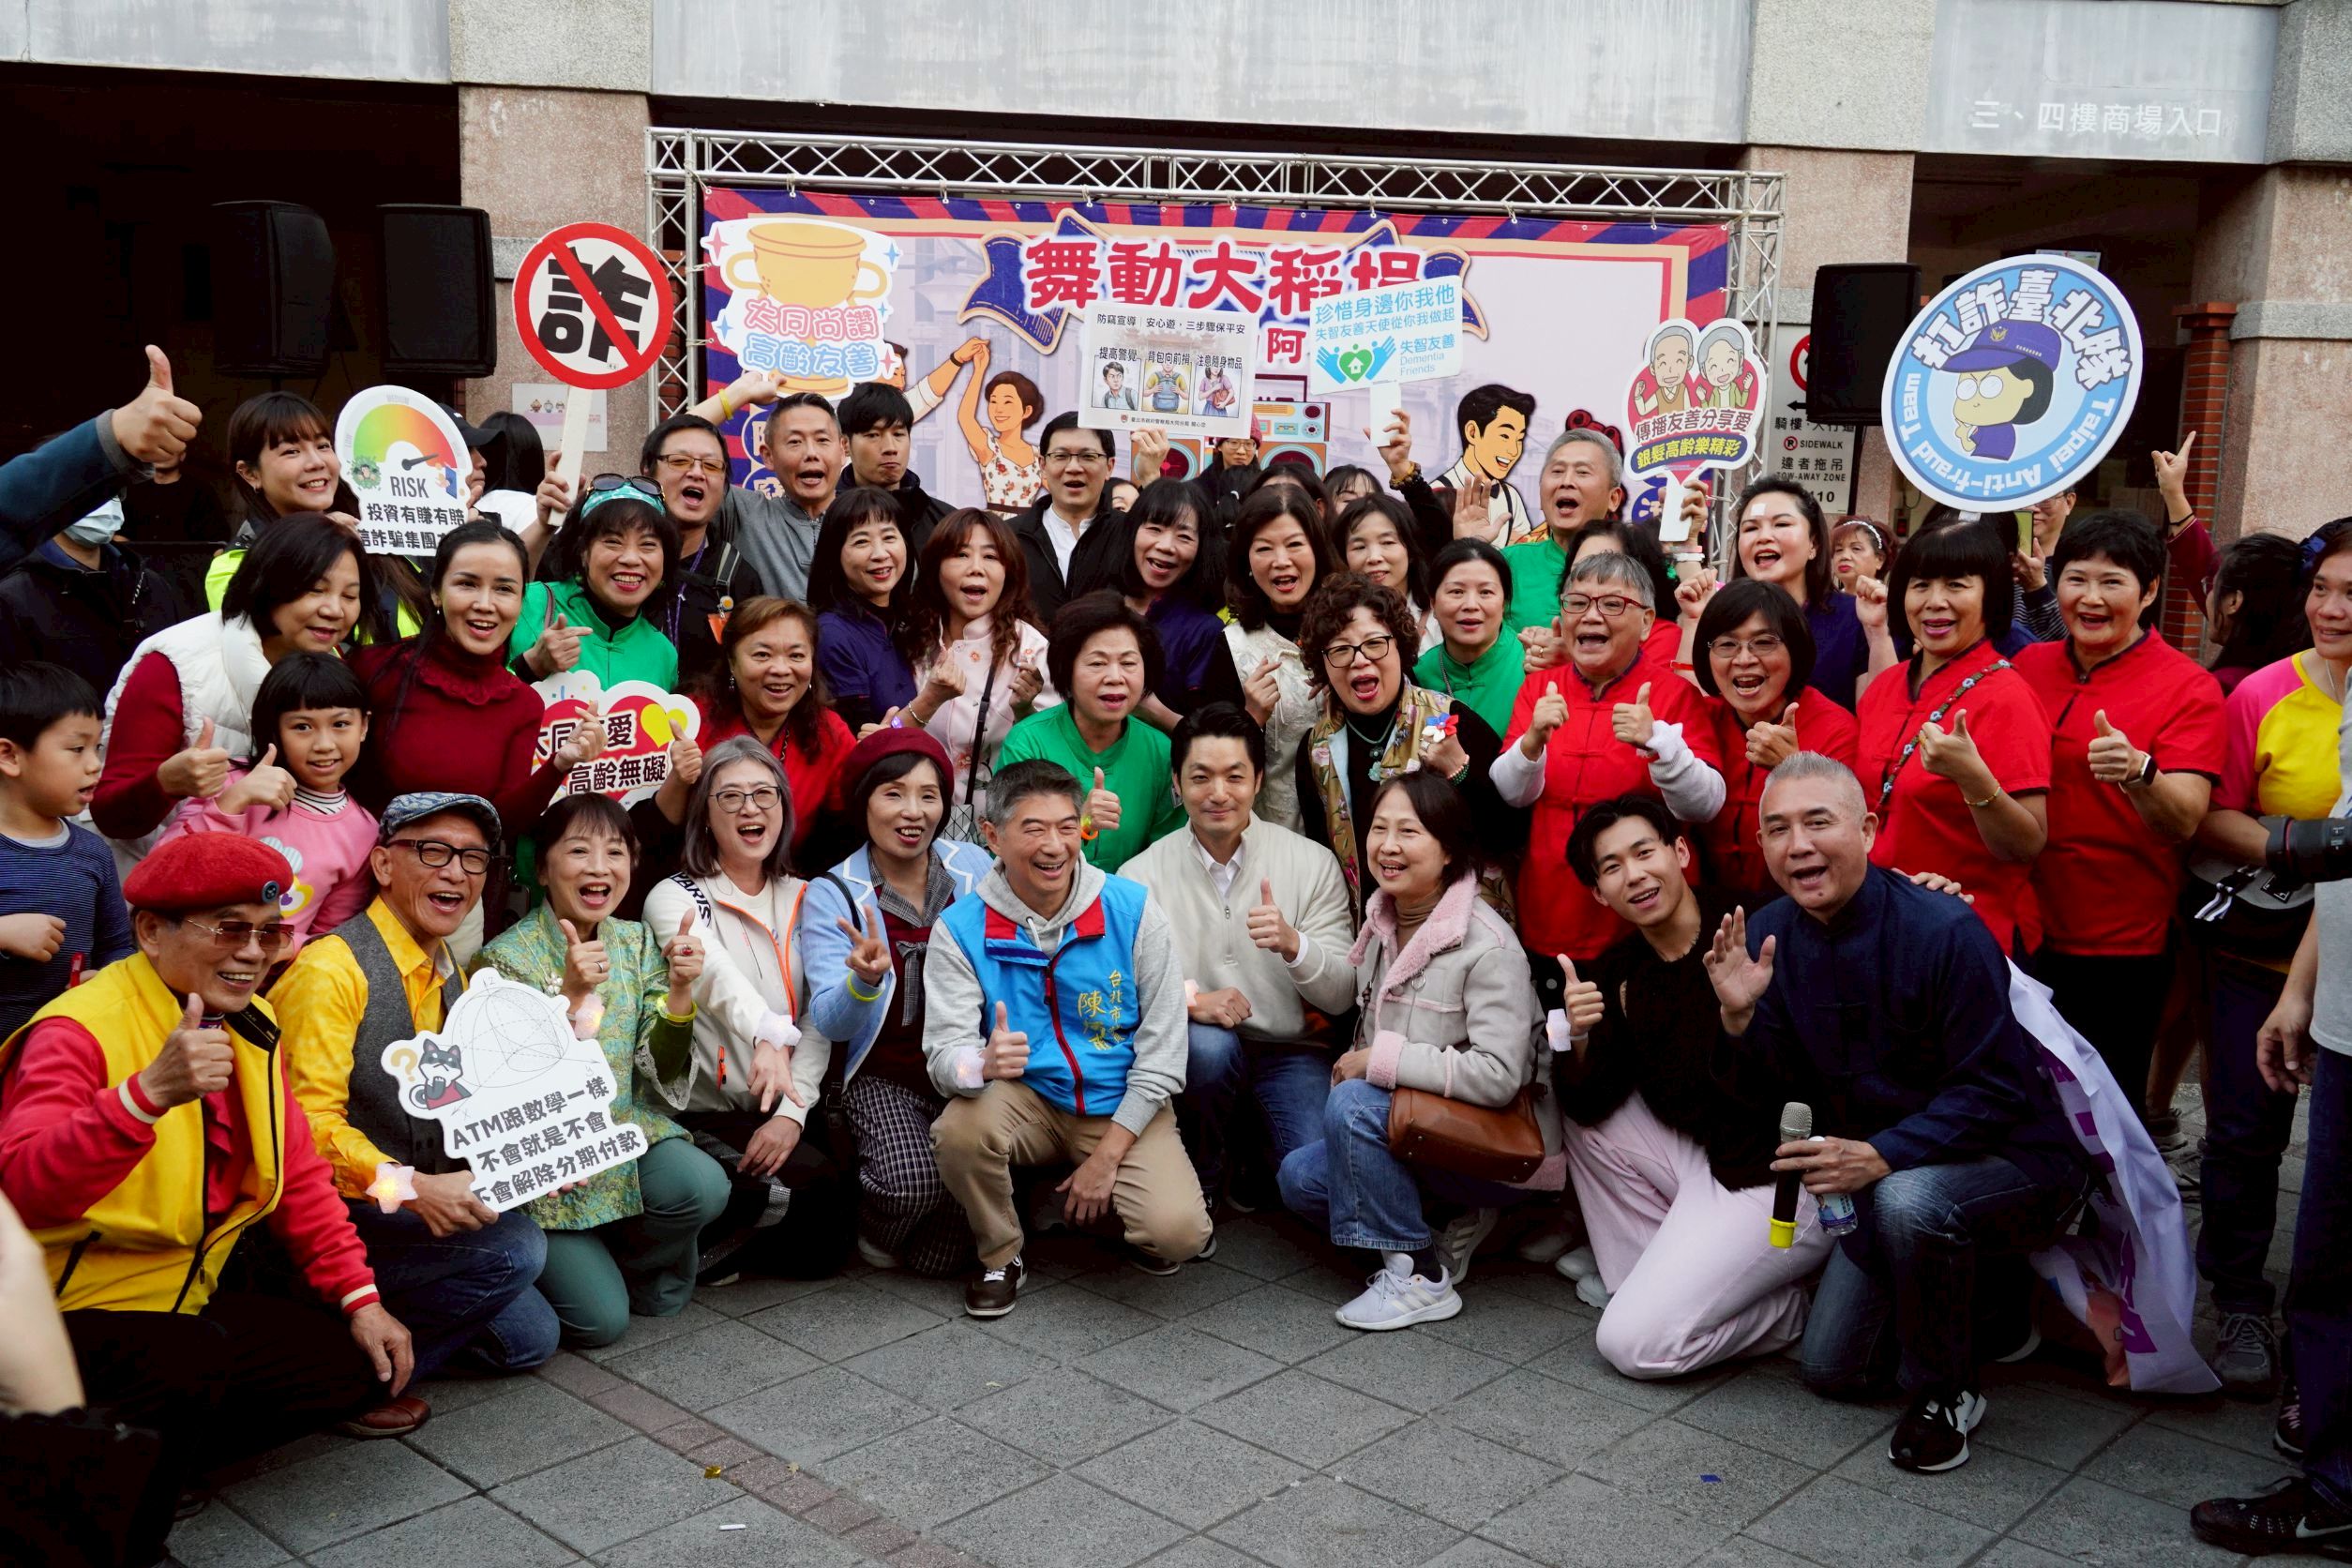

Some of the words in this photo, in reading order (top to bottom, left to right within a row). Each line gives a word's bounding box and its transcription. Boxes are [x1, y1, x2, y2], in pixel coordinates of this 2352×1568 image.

[1971, 100, 2223, 136] 三、四樓商場入口
[745, 299, 879, 341] 大同尚讚
[1096, 313, 1137, 326] 防竊宣導
[1315, 283, 1455, 324] 珍惜身邊你我他
[1315, 308, 1455, 342] 失智友善天使從你我做起
[1911, 268, 2133, 392] 打詐臺北隊
[743, 332, 879, 380] 高齡友善
[1099, 347, 1138, 362] 提高警覺
[1400, 334, 1455, 355] 失智友善
[1400, 351, 1444, 366] Dementia
[1196, 354, 1244, 369] 注意隨身物品
[1400, 363, 1436, 376] Friends
[1899, 372, 1922, 443] Team
[1636, 410, 1754, 443] 傳播友善分享愛
[2048, 398, 2117, 474] Taipei
[1637, 437, 1741, 469] 銀髮高齡樂精彩
[1800, 440, 1844, 449] SIDEWALK
[1776, 472, 1820, 482] TOW-AWAY
[1823, 474, 1847, 482] ZONE
[1781, 457, 1844, 471] 違者拖吊
[1910, 440, 2043, 496] Anti-fraud
[390, 475, 430, 499] RISK
[367, 503, 465, 525] 投資有賺有賠
[568, 754, 667, 795] 高齡無礙
[670, 872, 712, 923] PARIS
[452, 1076, 610, 1150] ATM跟數學一樣
[475, 1110, 608, 1173] 不會就是不會
